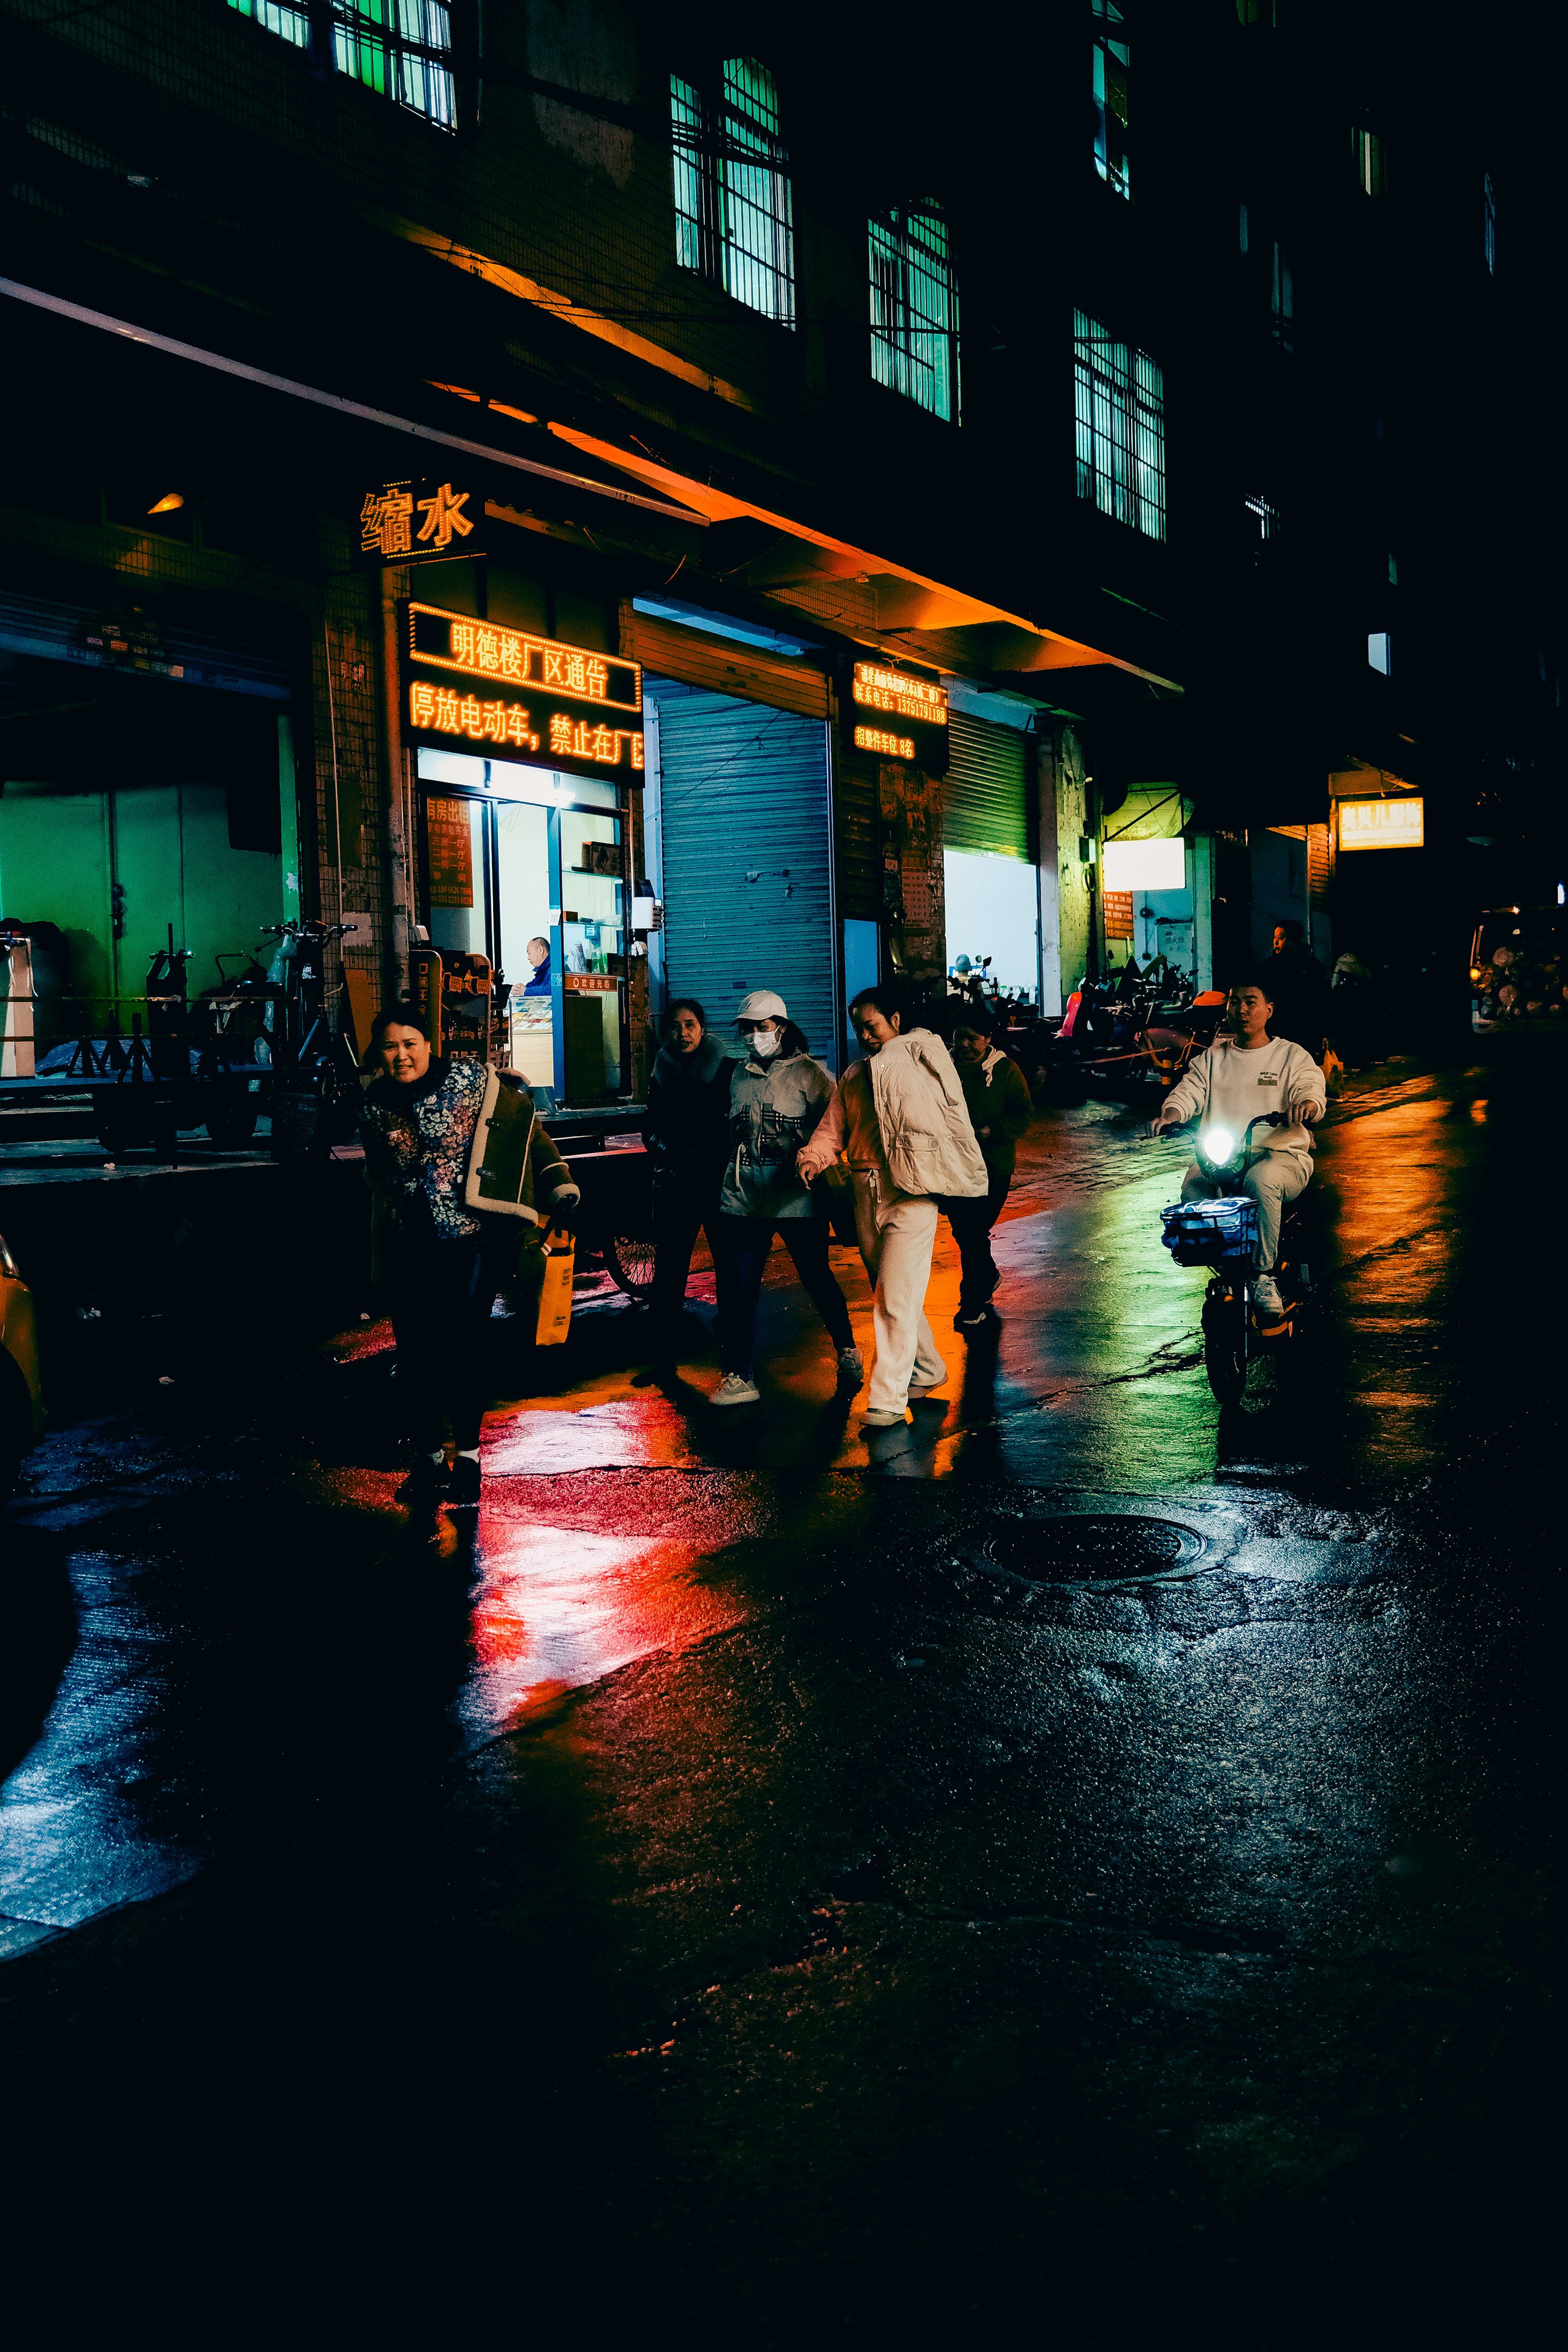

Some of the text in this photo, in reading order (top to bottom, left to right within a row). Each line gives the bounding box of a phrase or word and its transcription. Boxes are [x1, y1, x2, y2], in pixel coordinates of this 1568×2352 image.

[360, 483, 475, 554] 缩水
[453, 623, 608, 698] 明德楼厂区通告
[856, 727, 912, 757] 招整件车位 8名
[581, 979, 610, 989] 欢迎光临
